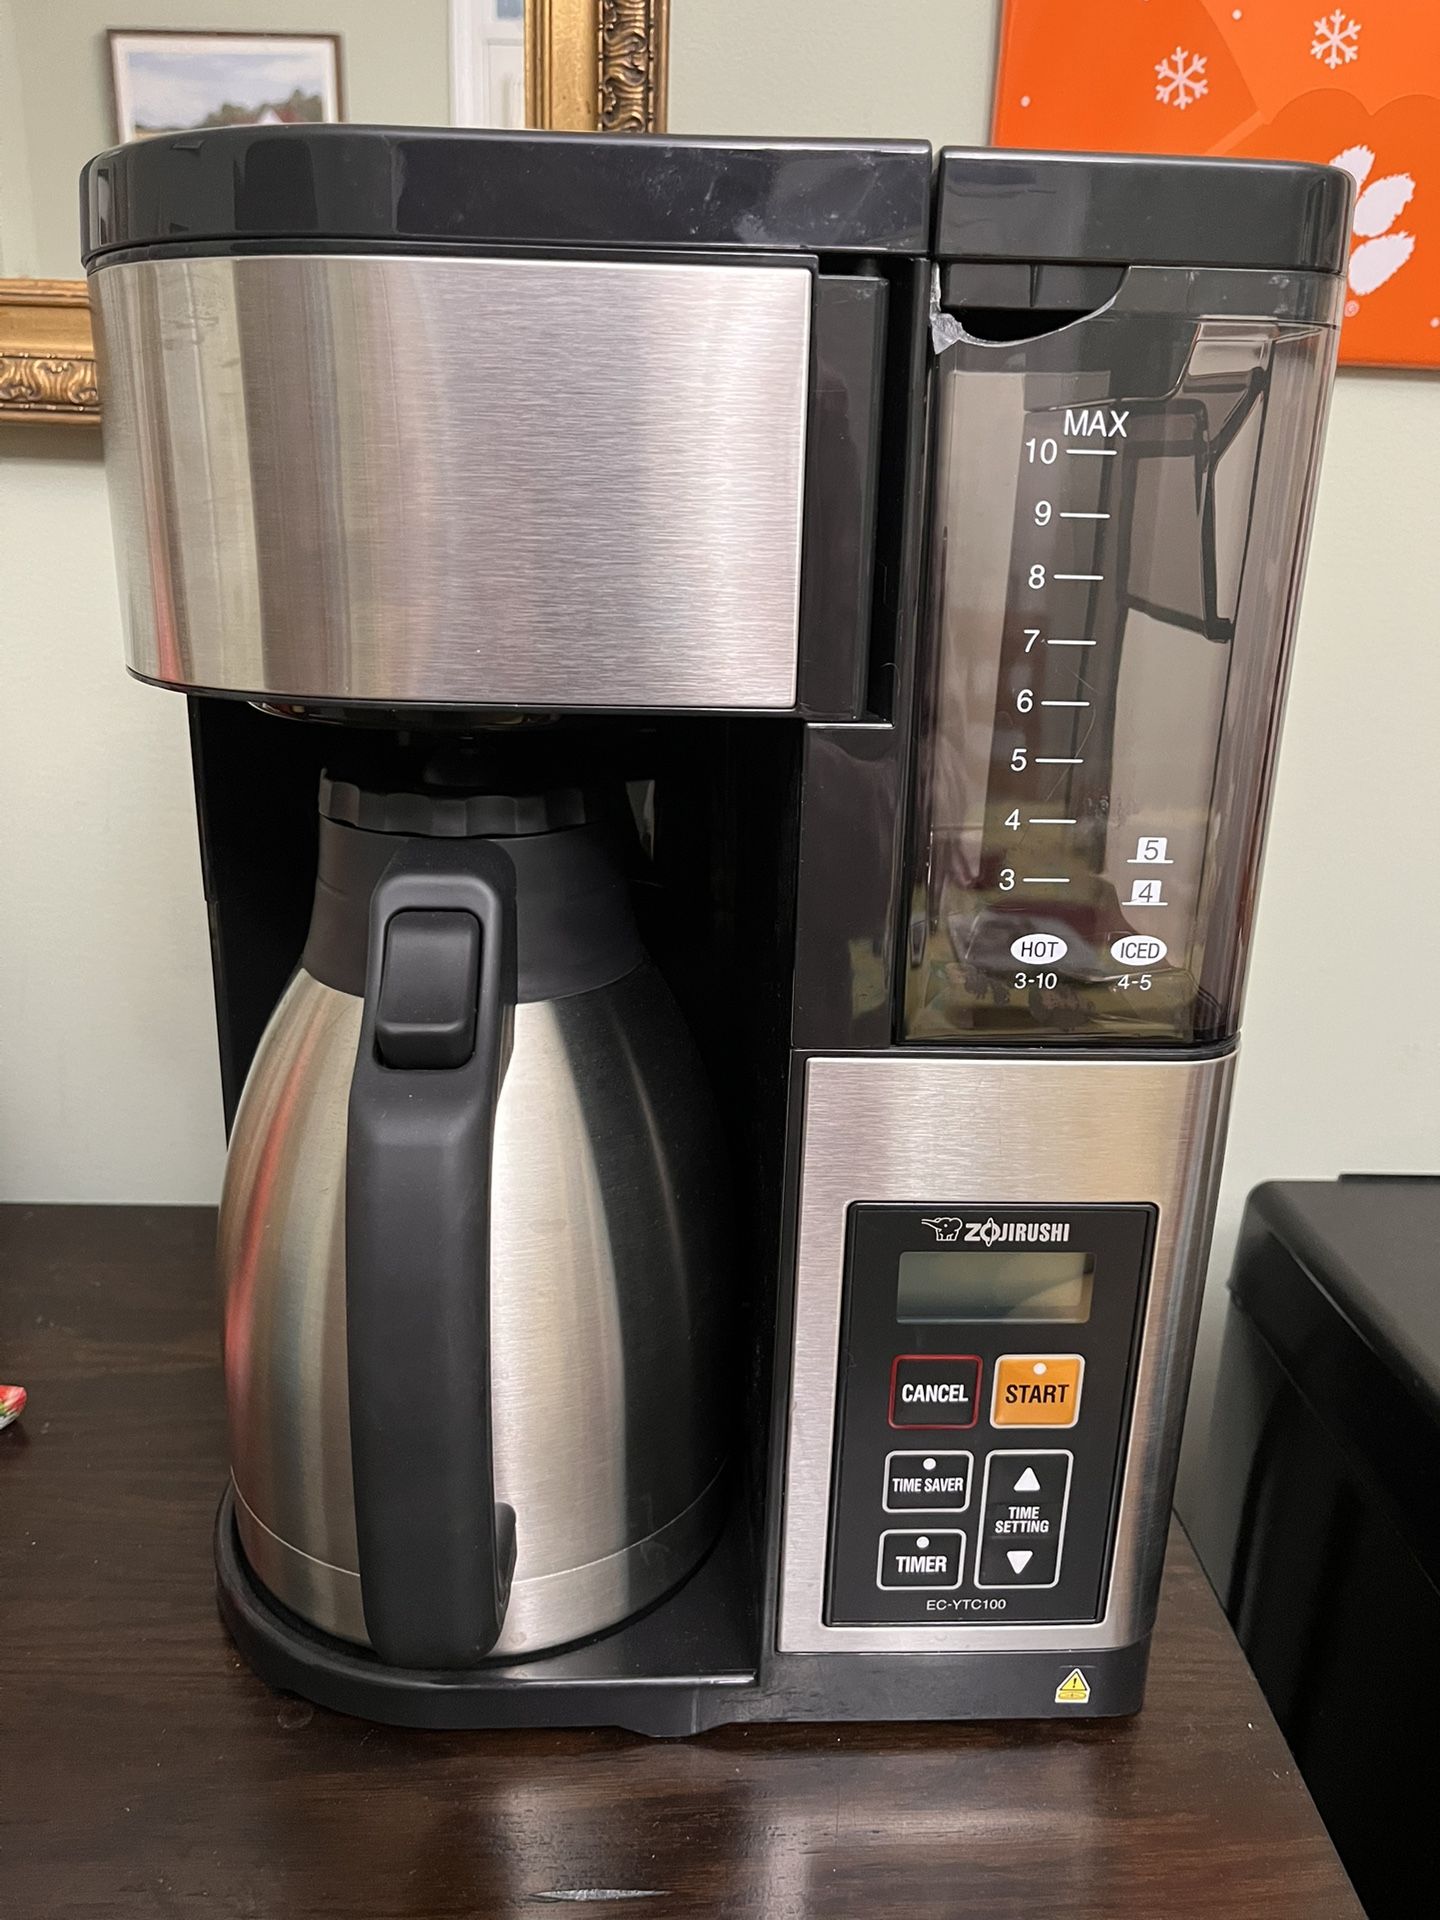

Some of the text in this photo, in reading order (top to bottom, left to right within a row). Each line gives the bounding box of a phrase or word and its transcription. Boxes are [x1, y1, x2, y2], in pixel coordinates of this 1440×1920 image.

[1063, 409, 1130, 438] MAX
[1025, 438, 1058, 465] 10
[1034, 500, 1052, 526] 9
[1028, 564, 1046, 590] 8
[1023, 629, 1041, 653] 7
[1016, 688, 1034, 713] 6
[1010, 748, 1028, 772] 5
[1004, 808, 1021, 831] 4
[1143, 839, 1160, 861] 5
[999, 868, 1016, 891] 3
[1138, 882, 1154, 904] 4
[1020, 941, 1059, 958] HOT
[1120, 942, 1161, 959] ICED
[1014, 972, 1058, 990] 3-10
[1117, 974, 1153, 991] 4-5
[964, 1217, 1071, 1247] ZOJIRUSHI
[901, 1383, 970, 1403] CANCEL
[1005, 1384, 1070, 1404] START
[892, 1477, 964, 1493] TIME SAVER
[1008, 1506, 1041, 1520] TIME
[994, 1519, 1050, 1534] SETTING
[895, 1555, 948, 1574] TIMER
[925, 1599, 1007, 1611] EC-YTC100
